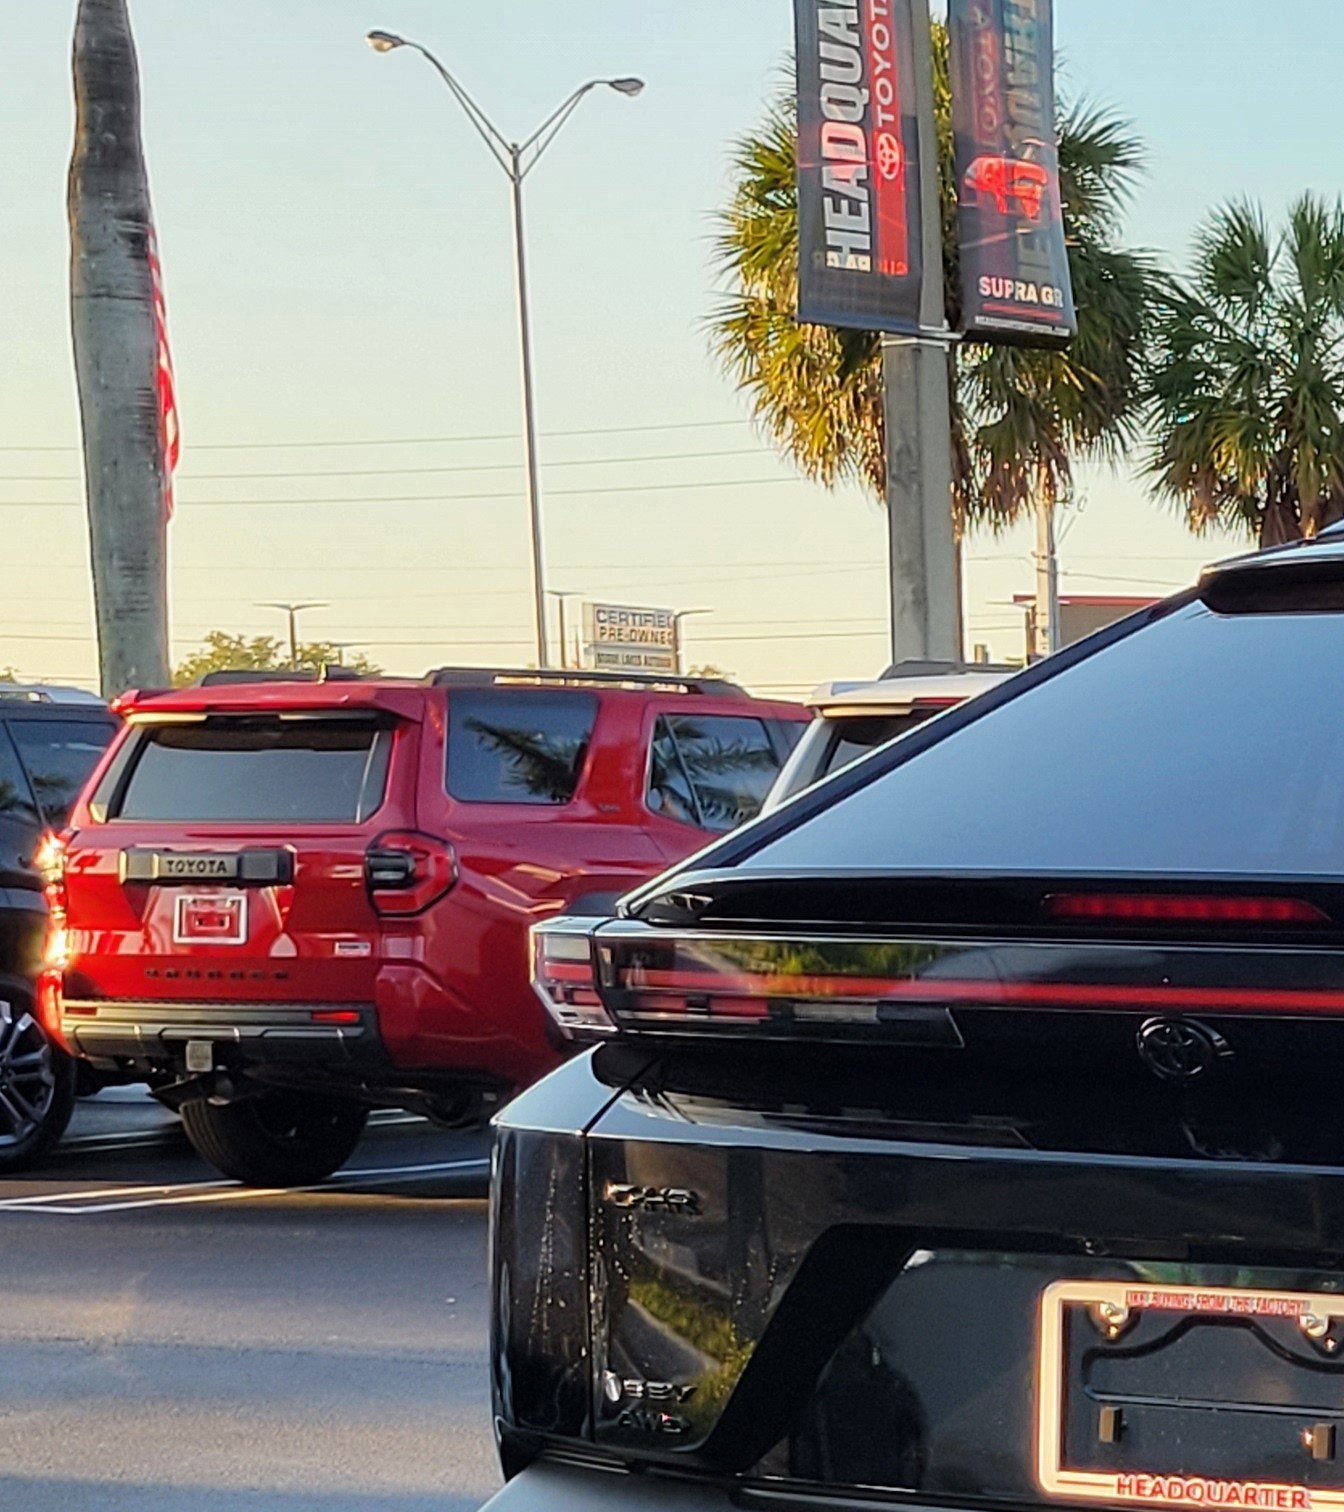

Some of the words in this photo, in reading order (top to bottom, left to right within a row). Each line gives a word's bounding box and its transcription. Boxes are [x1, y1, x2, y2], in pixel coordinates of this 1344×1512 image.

[870, 0, 896, 127] TOYOT
[817, 0, 871, 272] HEADQUA
[979, 276, 1038, 303] SUPRA
[1041, 286, 1064, 308] GR
[166, 859, 228, 874] TOYOTA
[1196, 1293, 1230, 1311] FROM
[1231, 1296, 1252, 1312] THE
[1256, 1297, 1302, 1316] FACTORY
[1117, 1474, 1311, 1509] HEADQUARTER
